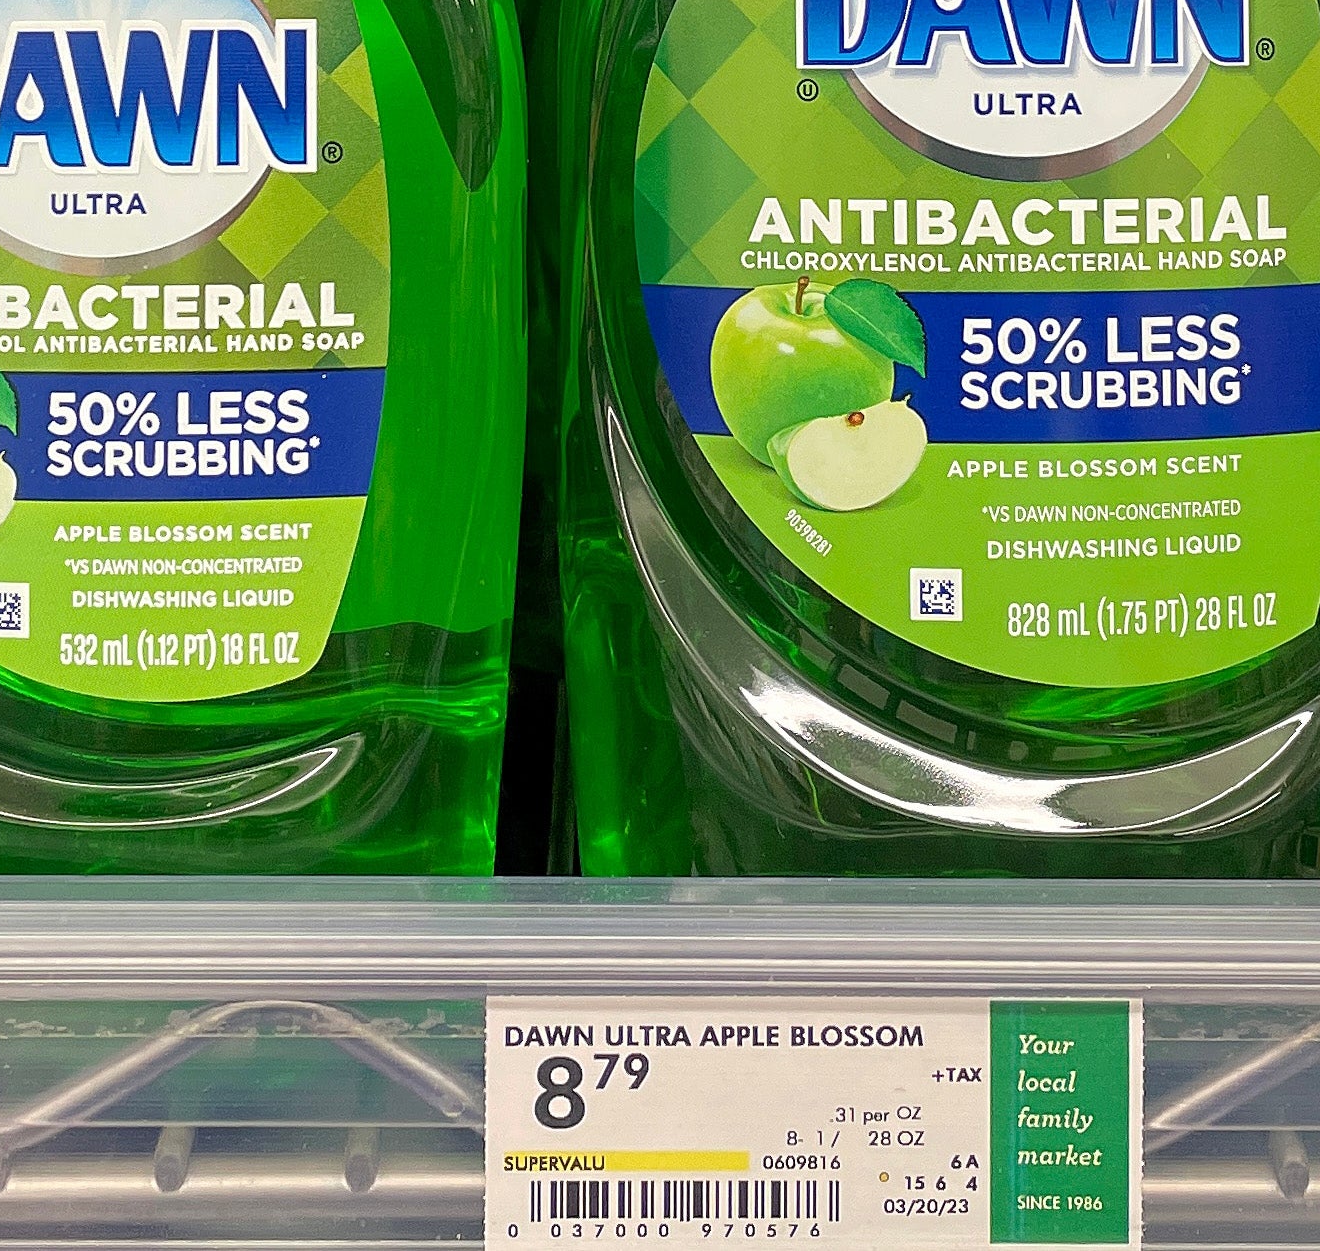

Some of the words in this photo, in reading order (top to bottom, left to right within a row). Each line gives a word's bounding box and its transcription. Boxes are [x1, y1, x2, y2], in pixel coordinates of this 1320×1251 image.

[974, 93, 1082, 115] ULTRA
[51, 194, 146, 214] ULTRA
[749, 195, 1286, 245] ANTIBACTERIAL
[741, 251, 950, 272] CHLOROXYLENOL
[958, 252, 1151, 272] ANTIBACTERIAL
[1159, 251, 1222, 270] HAND
[1230, 248, 1286, 267] SOAP
[34, 335, 217, 353] ANTIBACTERIAL
[227, 334, 293, 352] HAND
[302, 332, 364, 350] SOAP
[961, 318, 1086, 364] 50%
[1107, 314, 1240, 362] LESS
[48, 392, 160, 435] 50%
[178, 390, 309, 435] LESS
[947, 461, 1028, 478] APPLE
[1039, 458, 1156, 477] BLOSSOM
[1167, 455, 1241, 474] SCENT
[1015, 506, 1066, 522] DAWN
[1072, 500, 1241, 521] NON-CONCENTRATED
[54, 526, 121, 542] APPLE
[129, 525, 232, 542] BLOSSOM
[241, 523, 312, 540] SCENT
[784, 509, 832, 557] 90398281
[988, 538, 1157, 558] DISHWASHING
[1166, 534, 1240, 555] LIQUID
[92, 559, 138, 574] DAWN
[142, 557, 302, 575] NON-CONCENTRATED
[73, 590, 217, 608] DISHWASHING
[223, 589, 294, 607] LIQUID
[1008, 603, 1049, 636] 828
[1058, 603, 1090, 636] mL
[1098, 597, 1146, 640] (1.75
[1155, 594, 1188, 637] PT)
[1196, 597, 1220, 630] 28
[1228, 595, 1247, 628] FL
[1254, 593, 1276, 626] OZ
[60, 634, 98, 665] 532
[103, 634, 133, 665] mL
[137, 629, 178, 670] (1.12
[184, 629, 216, 670] PT)
[221, 633, 243, 665] 18
[249, 633, 270, 664] FL
[274, 632, 299, 663] OZ
[505, 1026, 593, 1046] DAWN
[606, 1026, 691, 1046] ULTRA
[700, 1026, 778, 1046] APPLE
[791, 1026, 923, 1046] BLOSSOM
[1019, 1035, 1074, 1054] Your
[932, 1068, 982, 1082] +TAX
[1018, 1070, 1076, 1092] local
[535, 1057, 585, 1129] 8
[594, 1053, 649, 1089] 79
[831, 1108, 854, 1122] .31
[864, 1112, 889, 1125] per
[897, 1106, 921, 1119] OZ
[1018, 1107, 1093, 1133] family
[869, 1131, 890, 1146] 28
[898, 1131, 924, 1145] OZ
[504, 1156, 604, 1171] SUPERVALU
[763, 1155, 840, 1169] 0609816
[1018, 1145, 1102, 1165] market
[884, 1199, 968, 1216] 03/20/23
[1018, 1195, 1060, 1209] SINCE
[1068, 1196, 1102, 1210] 1986
